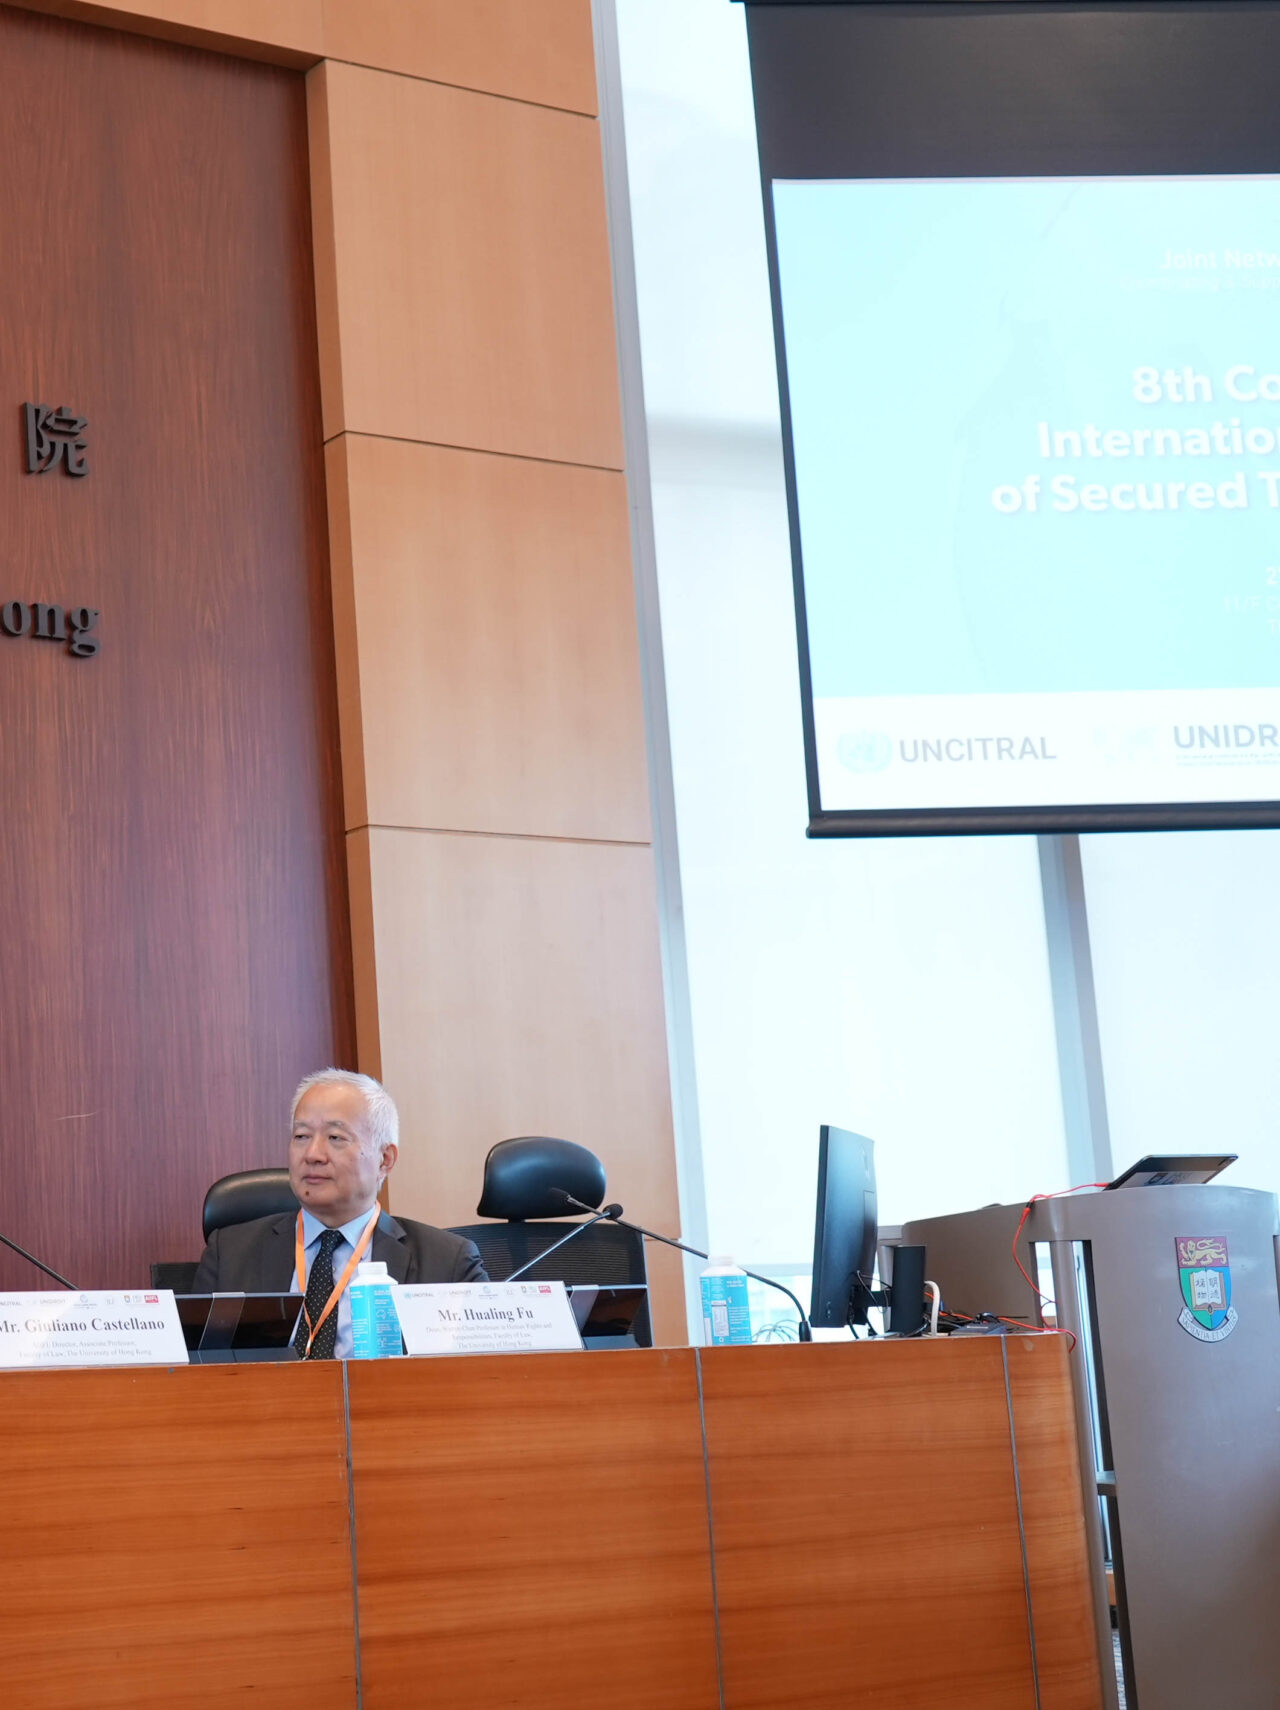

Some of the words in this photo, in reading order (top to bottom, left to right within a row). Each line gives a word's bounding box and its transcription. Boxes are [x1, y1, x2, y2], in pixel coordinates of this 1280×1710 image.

[1160, 248, 1218, 270] Joint
[1131, 365, 1213, 403] 8th
[1037, 417, 1280, 458] Internatio
[991, 474, 1041, 513] of
[1050, 471, 1248, 512] Secured
[898, 736, 1058, 763] UNCITRAL
[1173, 723, 1280, 750] UNIDR
[24, 1318, 87, 1333] Giuliano
[91, 1317, 165, 1331] Castellano
[438, 1309, 462, 1321] Mr.
[464, 1307, 515, 1322] Hualing
[517, 1306, 534, 1319] Fu
